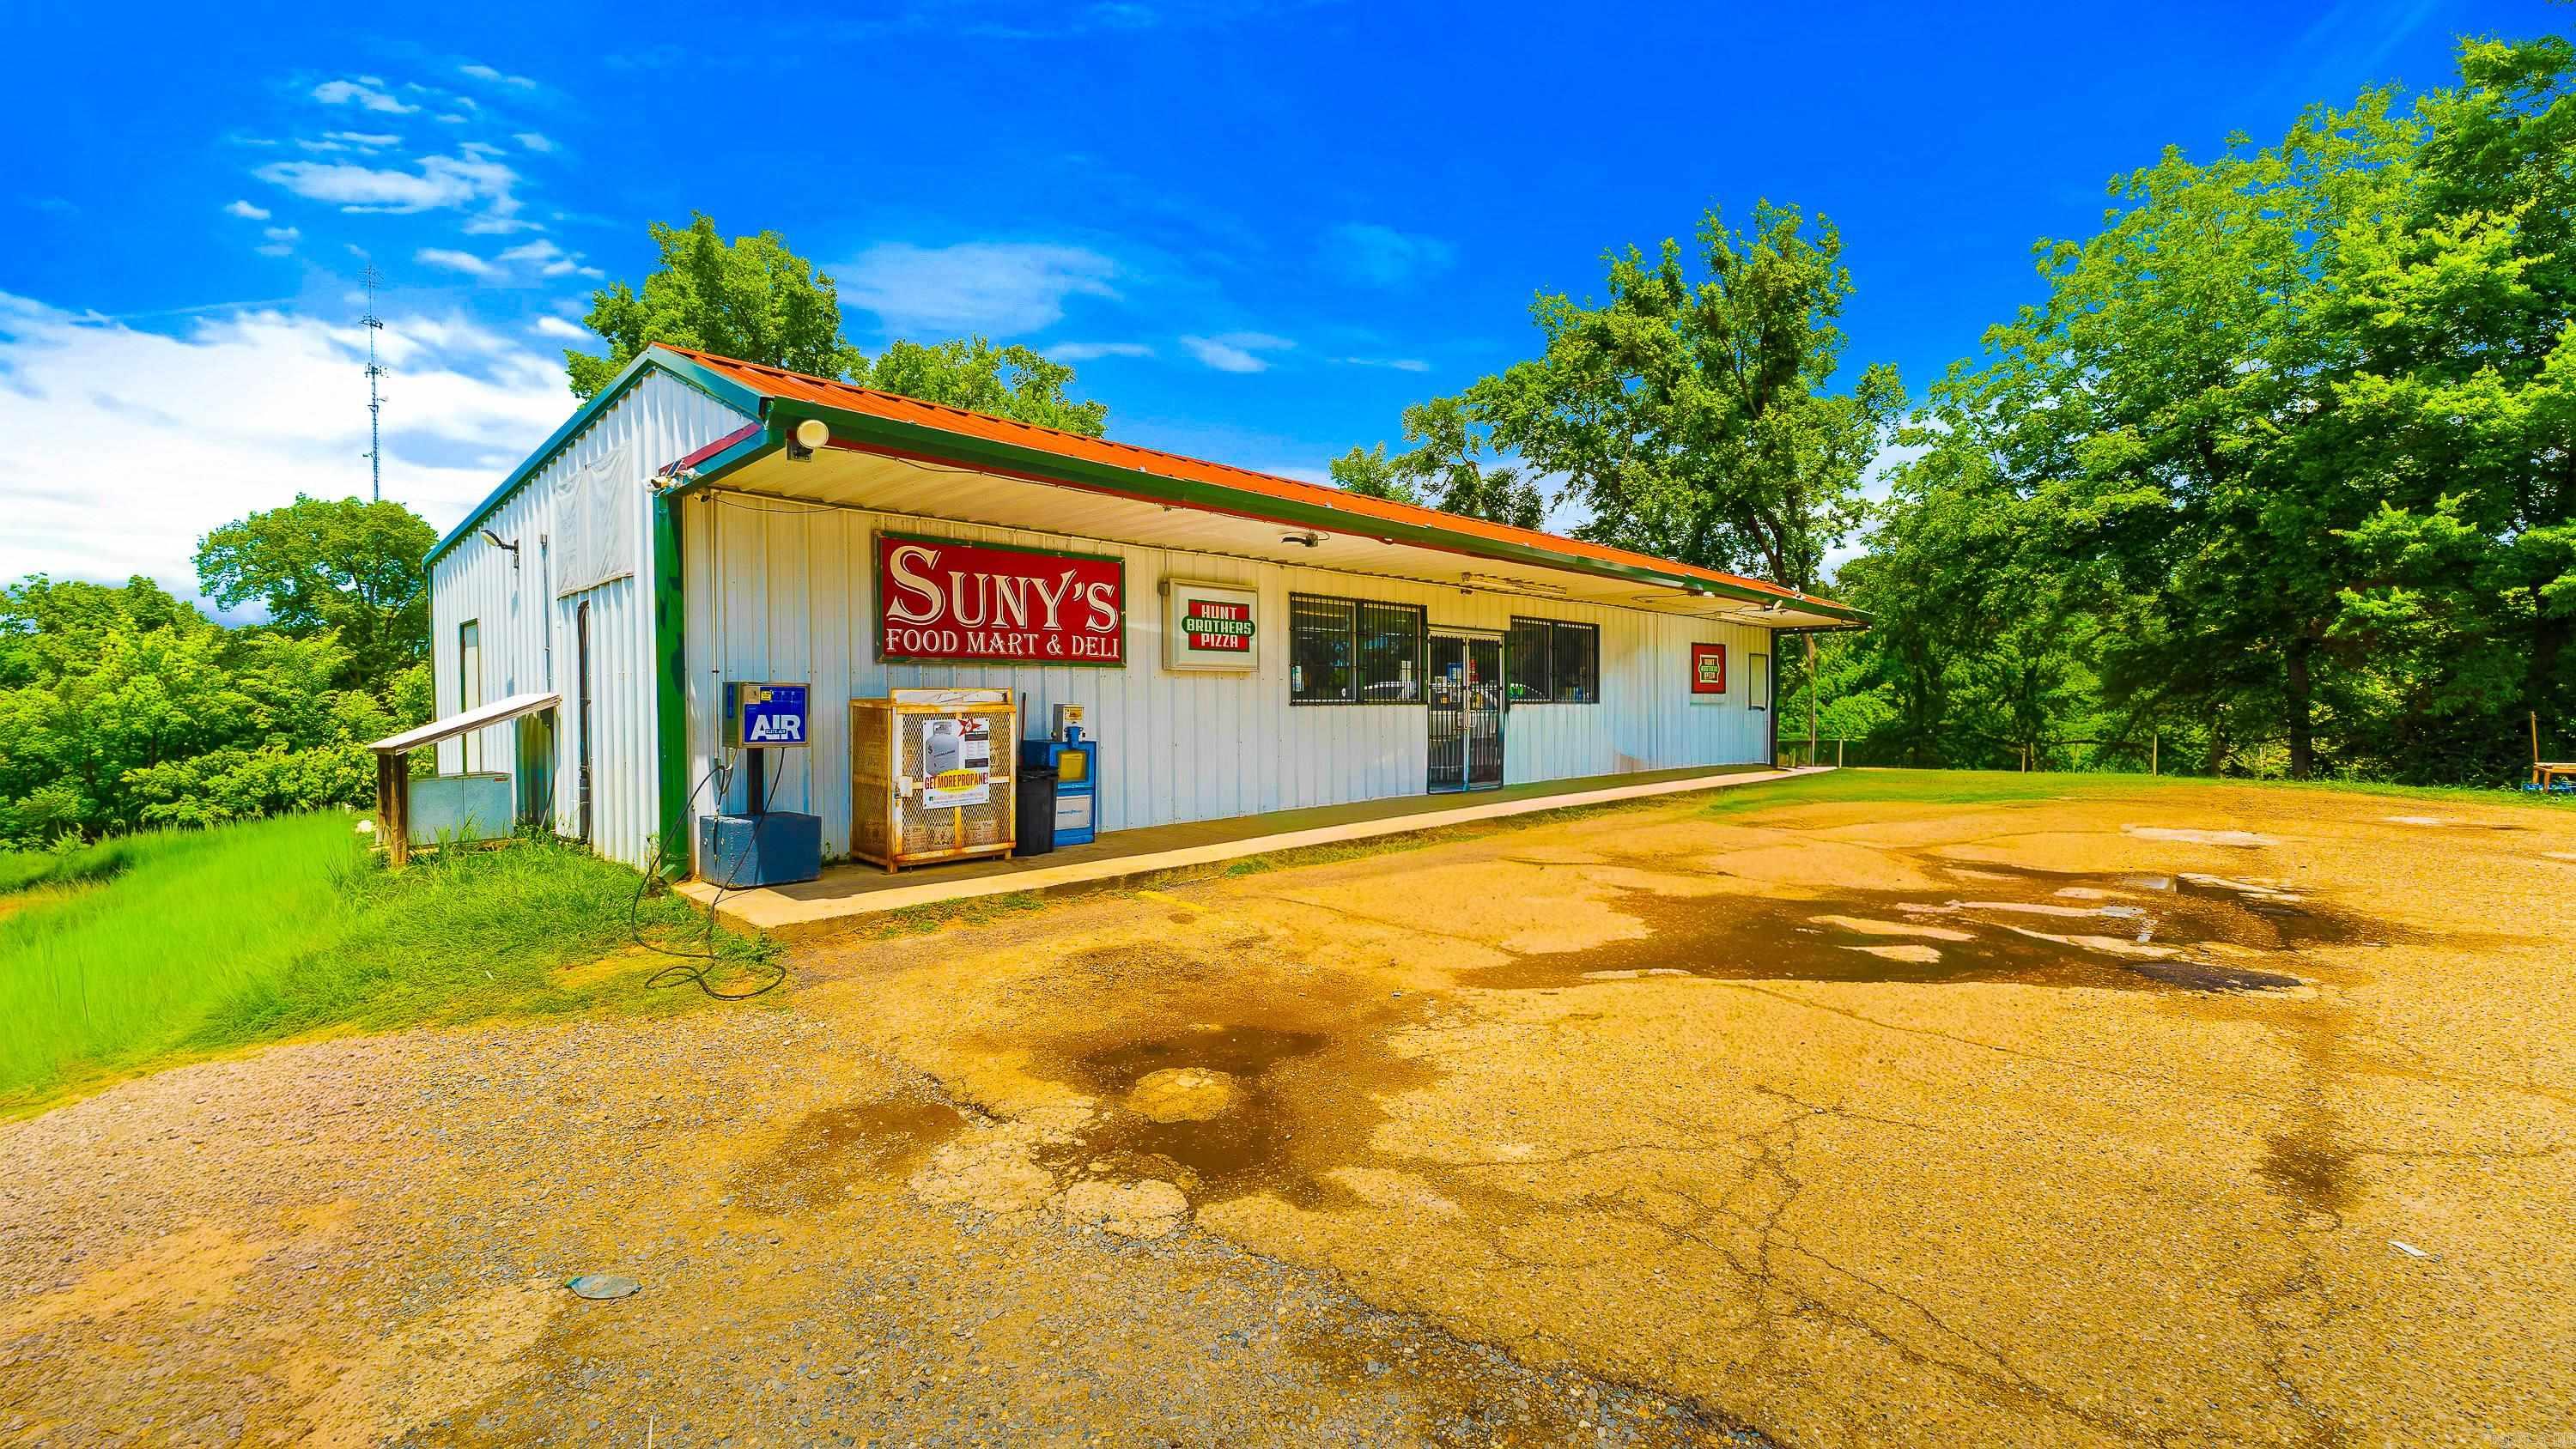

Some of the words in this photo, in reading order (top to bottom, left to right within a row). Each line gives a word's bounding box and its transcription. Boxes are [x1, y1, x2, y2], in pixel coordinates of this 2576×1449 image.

[886, 545, 1118, 634] SUNY'S
[1201, 604, 1236, 620] HUNT
[1187, 618, 1251, 634] BROTHERS
[886, 628, 958, 652] FOOD
[966, 631, 1039, 656] MART
[1046, 634, 1064, 655] &
[1071, 634, 1120, 658] DELI
[1201, 633, 1238, 648] PIZZA
[750, 714, 801, 740] AIR
[925, 776, 937, 790] GET
[937, 774, 957, 789] MORE
[957, 772, 989, 787] PROPANE!
